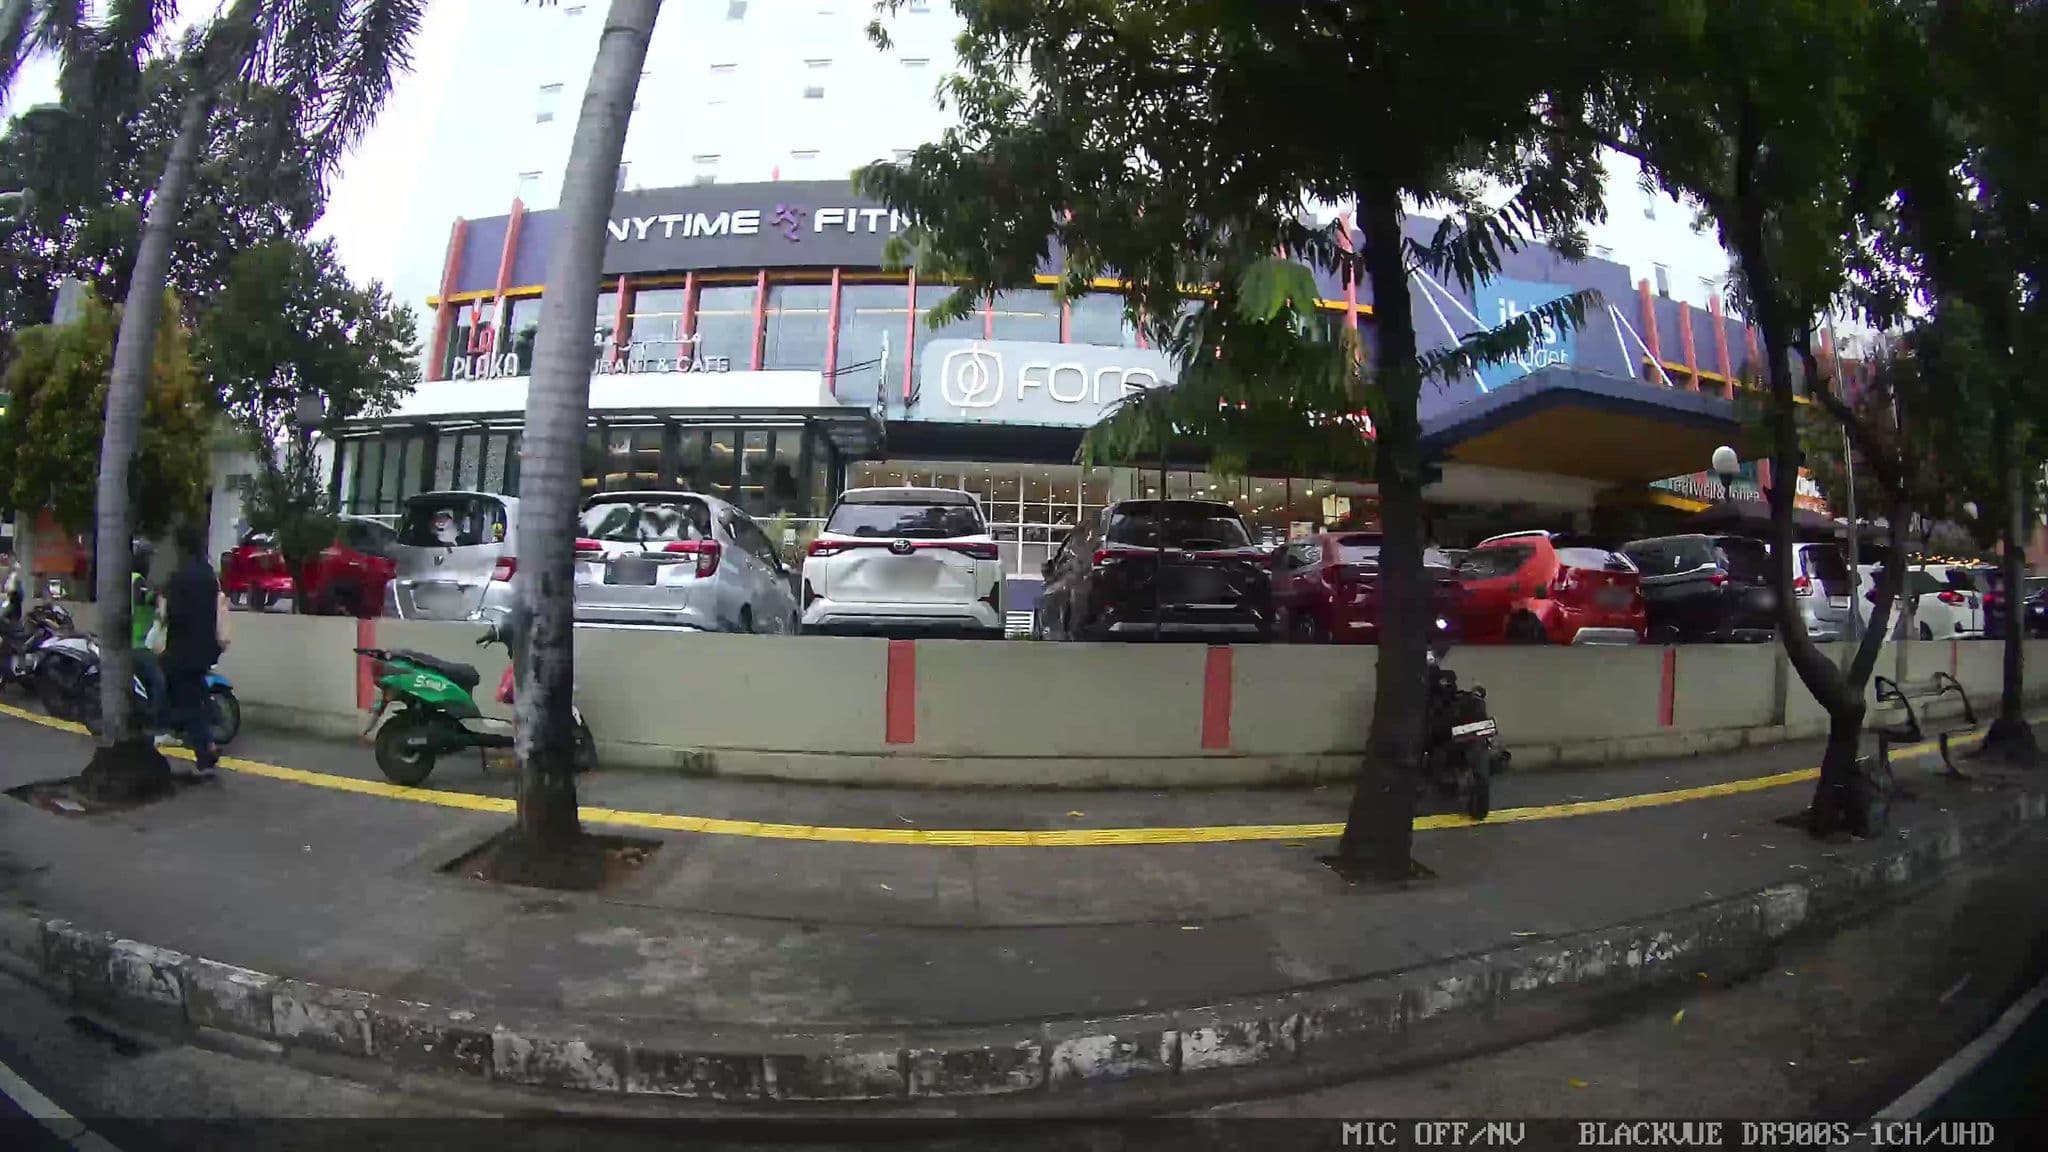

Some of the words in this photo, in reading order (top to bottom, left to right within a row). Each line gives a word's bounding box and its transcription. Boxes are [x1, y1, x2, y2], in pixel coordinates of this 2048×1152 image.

[606, 209, 761, 242] NYTIME
[656, 357, 670, 374] &
[676, 354, 731, 375] CAFE
